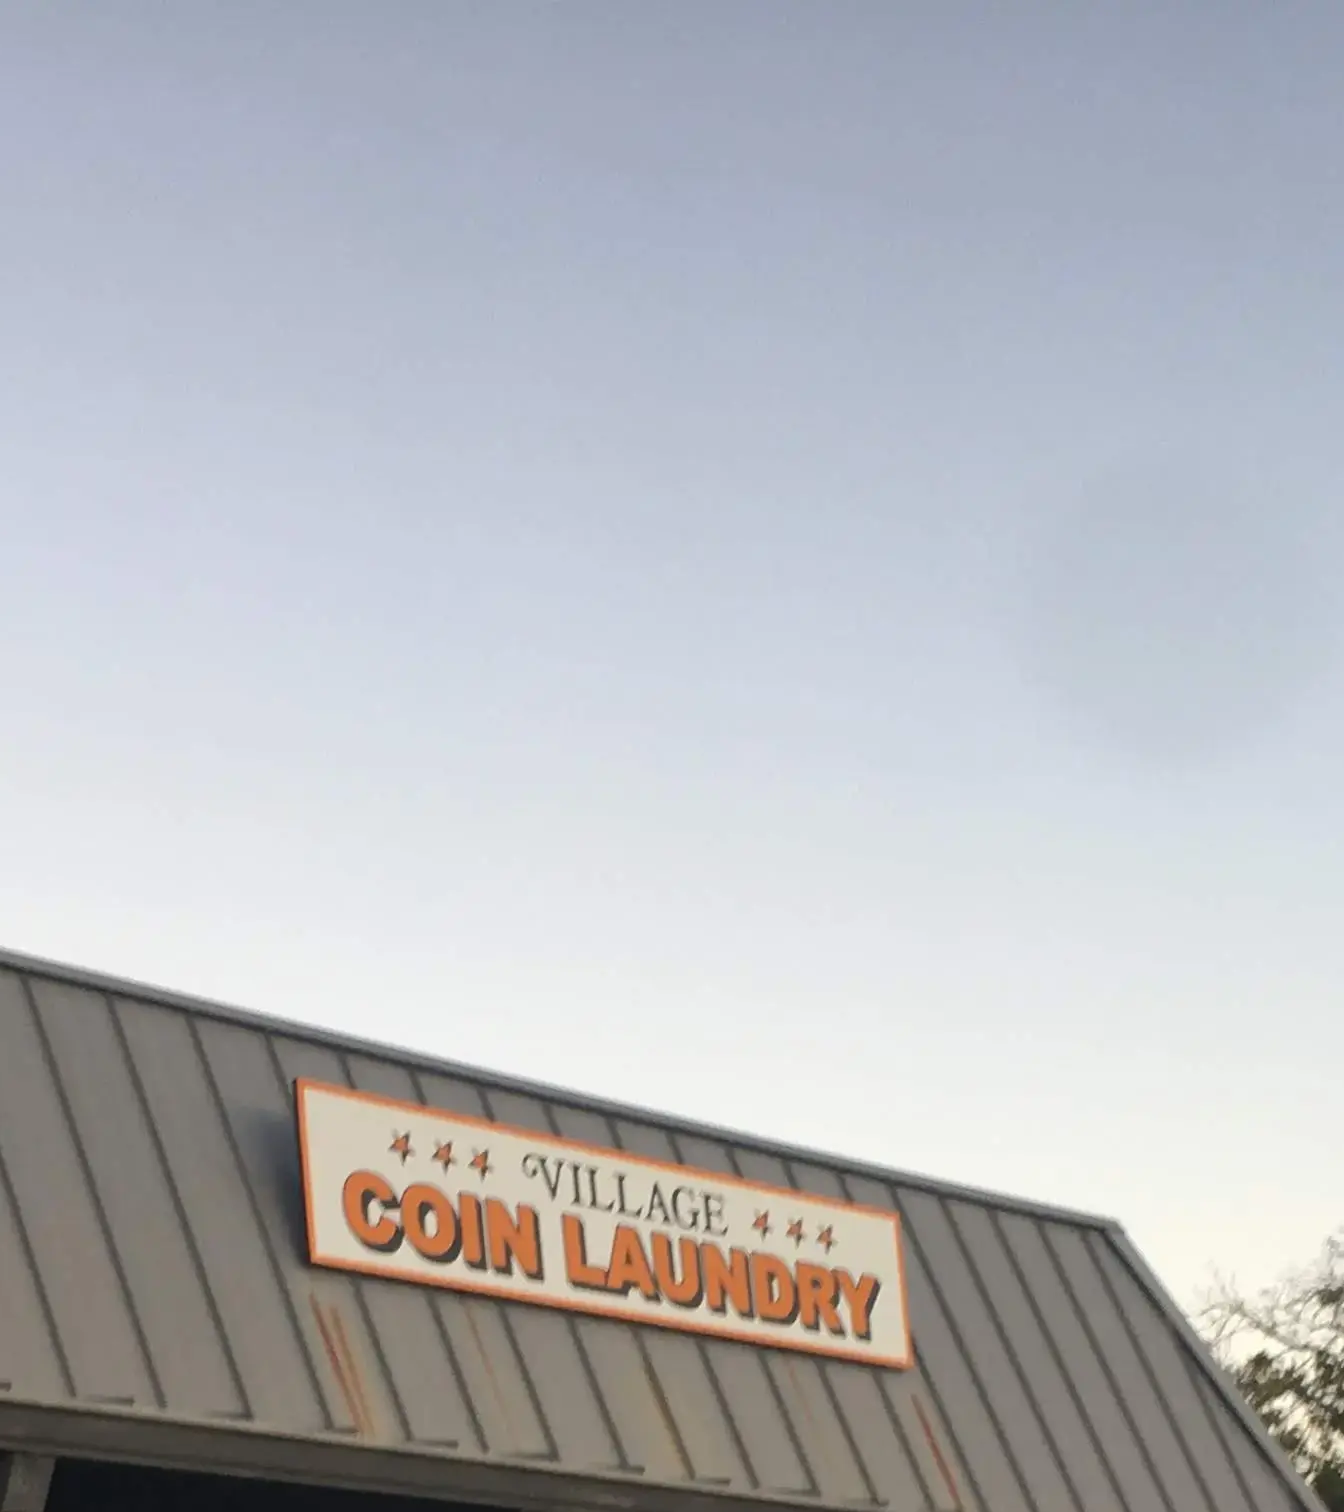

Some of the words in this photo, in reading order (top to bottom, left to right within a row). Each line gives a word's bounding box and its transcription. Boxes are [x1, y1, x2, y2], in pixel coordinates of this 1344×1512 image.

[342, 1169, 544, 1281] COIN
[562, 1212, 881, 1341] LAUNDRY
[521, 1150, 729, 1237] VILLAGE
